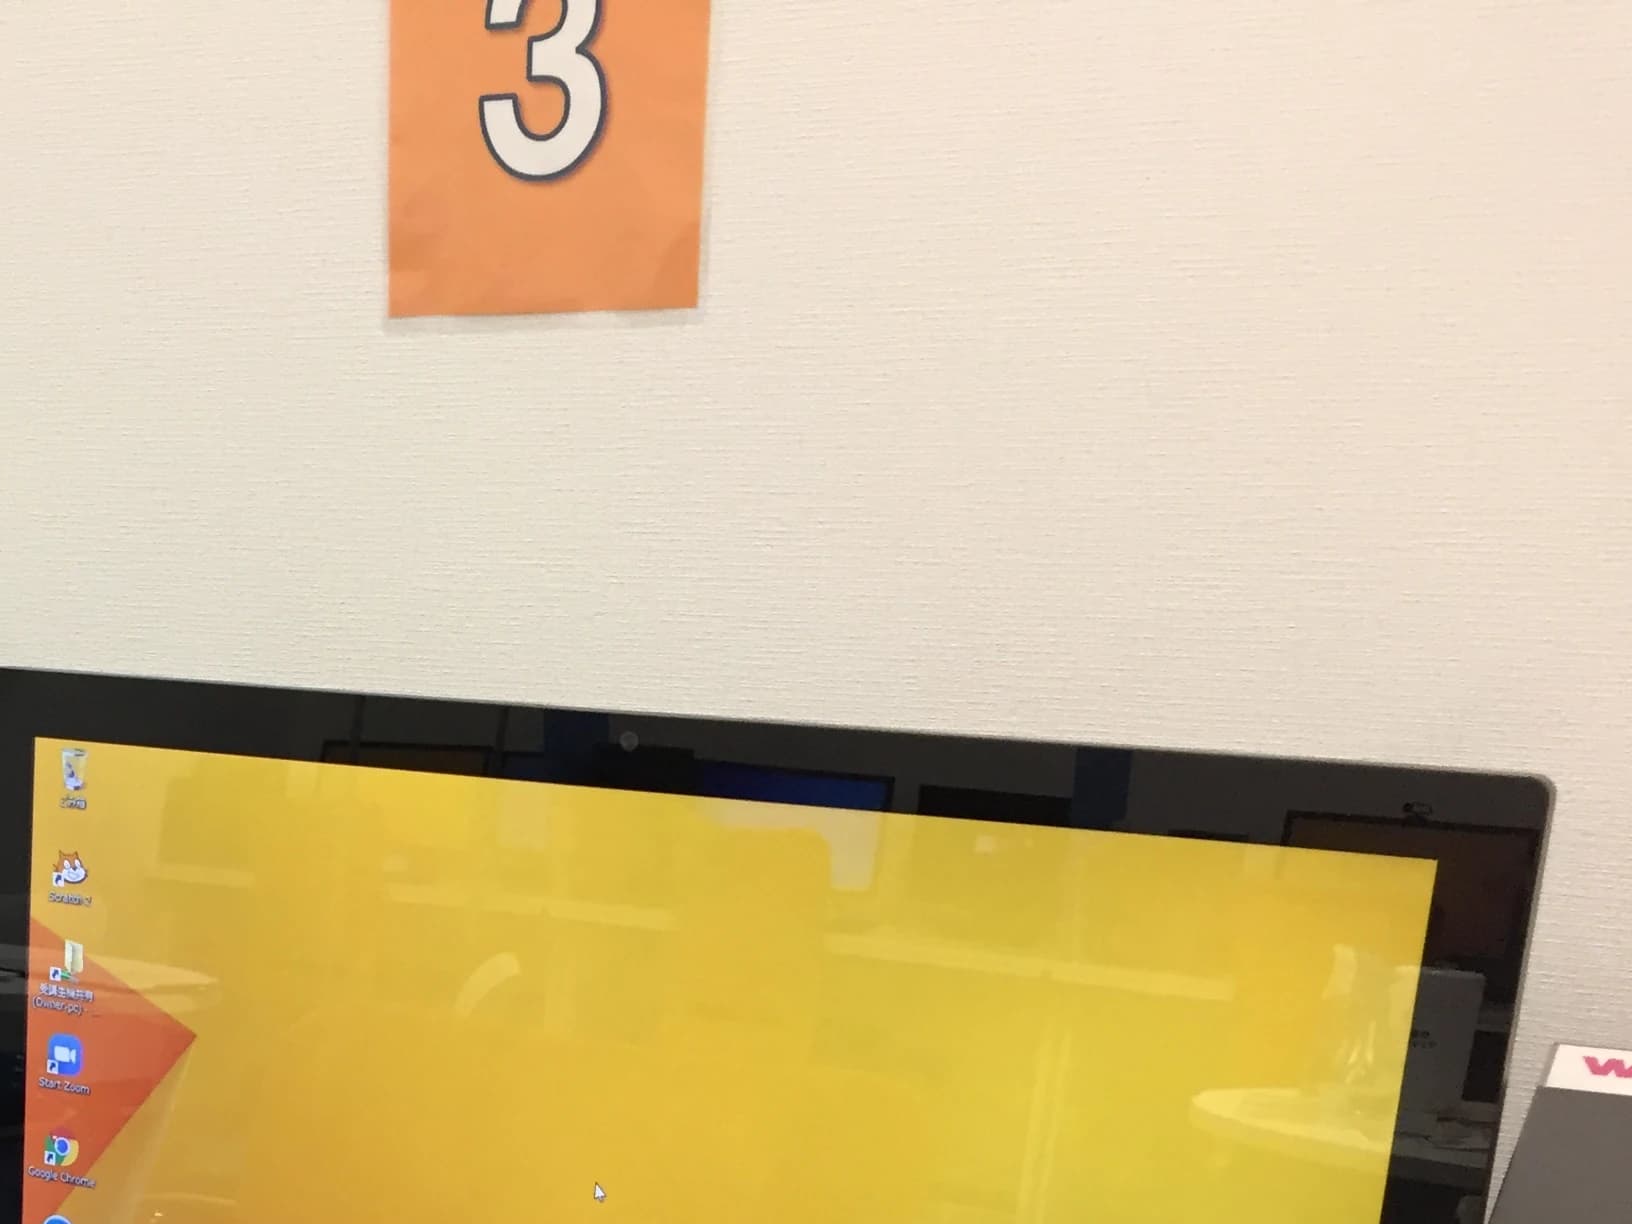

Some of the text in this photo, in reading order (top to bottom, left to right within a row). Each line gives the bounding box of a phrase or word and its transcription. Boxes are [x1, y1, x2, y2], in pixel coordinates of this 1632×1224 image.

[479, 0, 612, 183] 3
[39, 1077, 92, 1096] Start Zoom
[28, 1166, 96, 1189] Google Chrome
